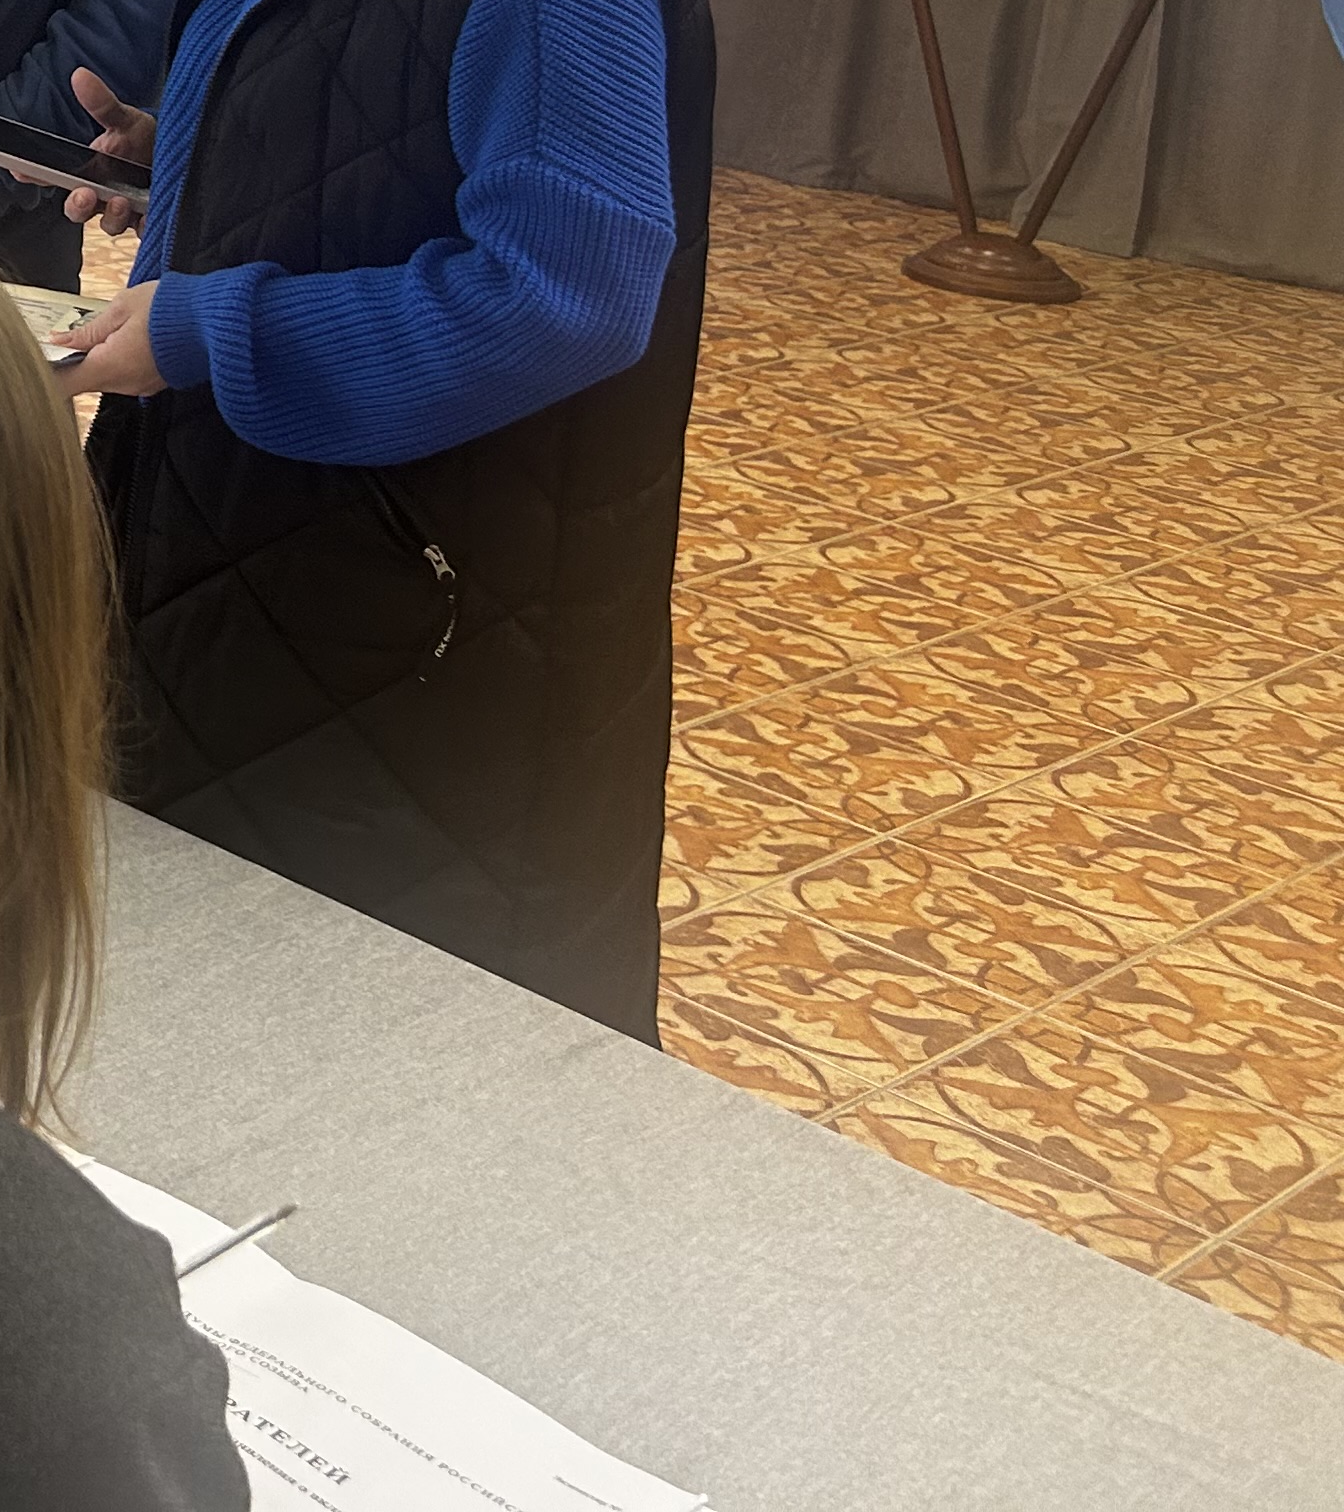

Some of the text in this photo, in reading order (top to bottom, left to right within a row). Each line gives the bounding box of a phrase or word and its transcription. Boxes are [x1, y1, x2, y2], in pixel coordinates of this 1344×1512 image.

[228, 1337, 348, 1404] ФЕДЕРАЛЬНОГО
[437, 1462, 524, 1512] РОССИЙС
[249, 1355, 309, 1393] СОЗЫВА
